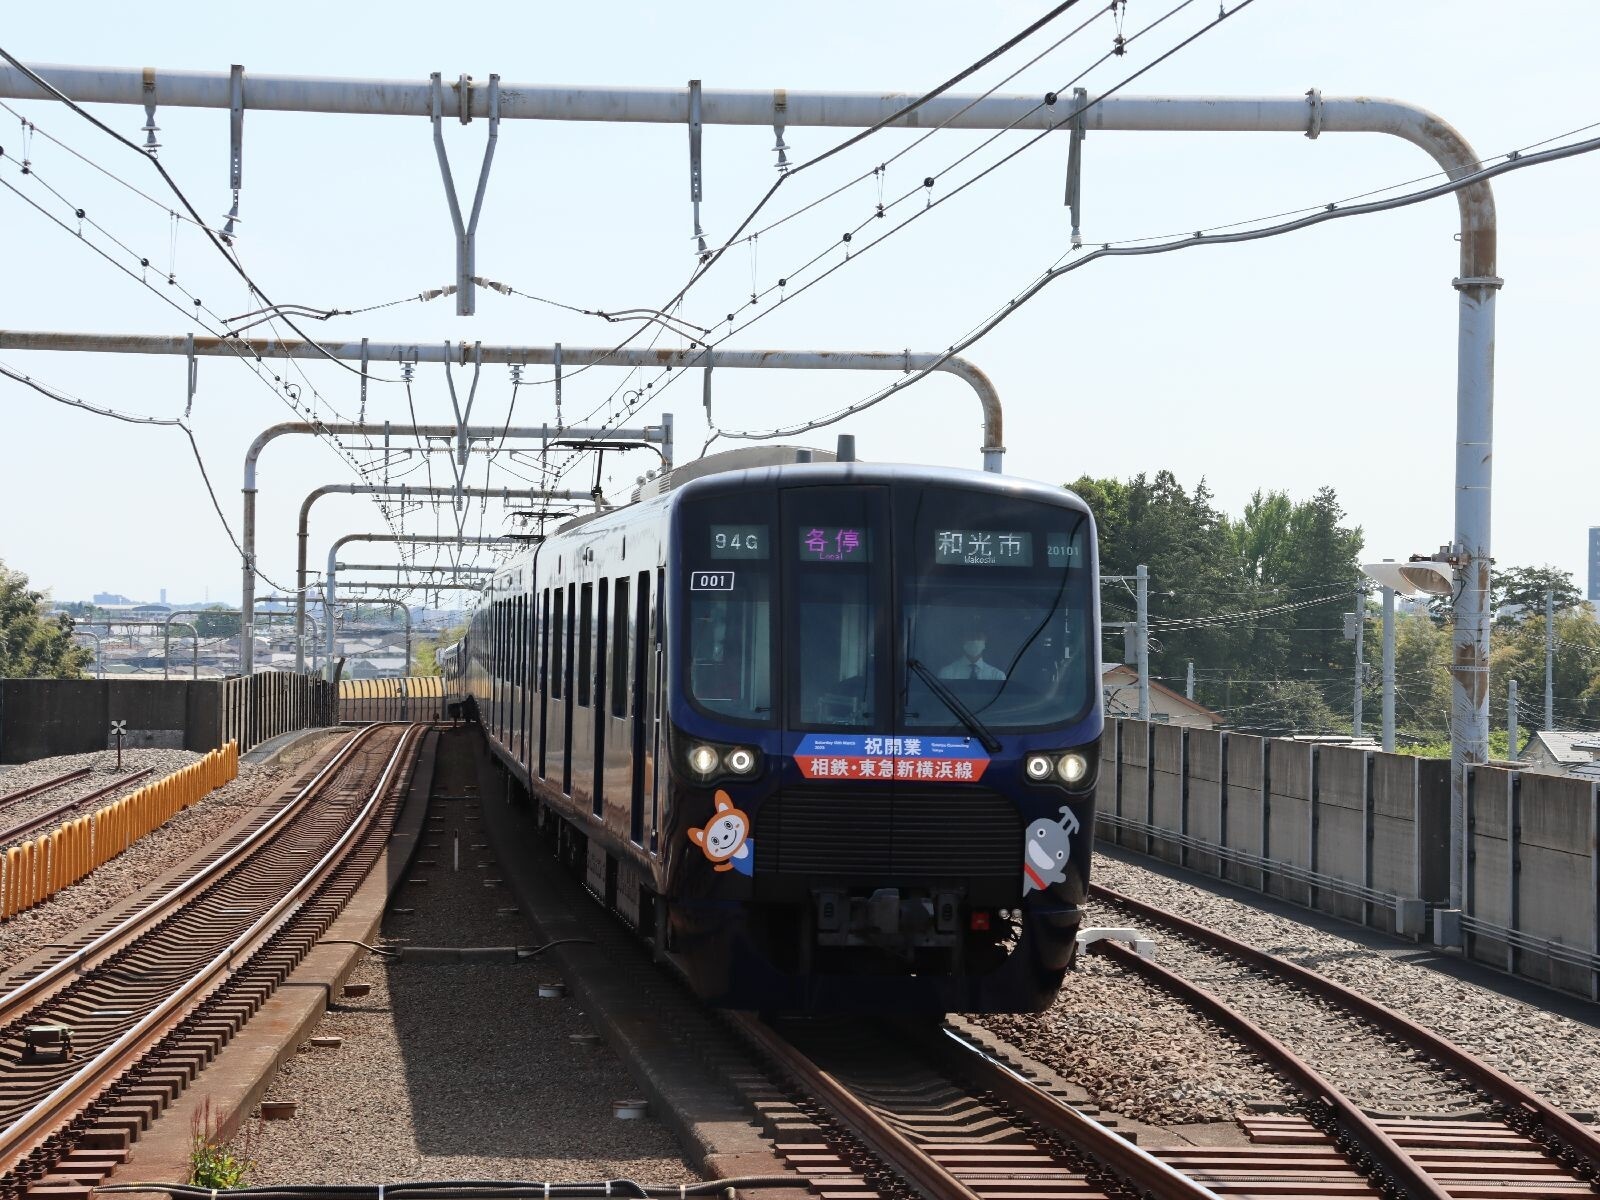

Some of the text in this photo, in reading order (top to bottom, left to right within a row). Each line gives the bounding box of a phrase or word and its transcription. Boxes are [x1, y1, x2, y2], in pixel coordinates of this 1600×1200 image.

[715, 533, 758, 550] 94G
[805, 528, 860, 553] 各停
[938, 531, 1023, 557] 和光市
[1047, 545, 1079, 556] 20101
[700, 575, 725, 587] 001
[864, 737, 922, 756] 祝開業
[810, 757, 973, 780] 相鉄・東急新横浜線
